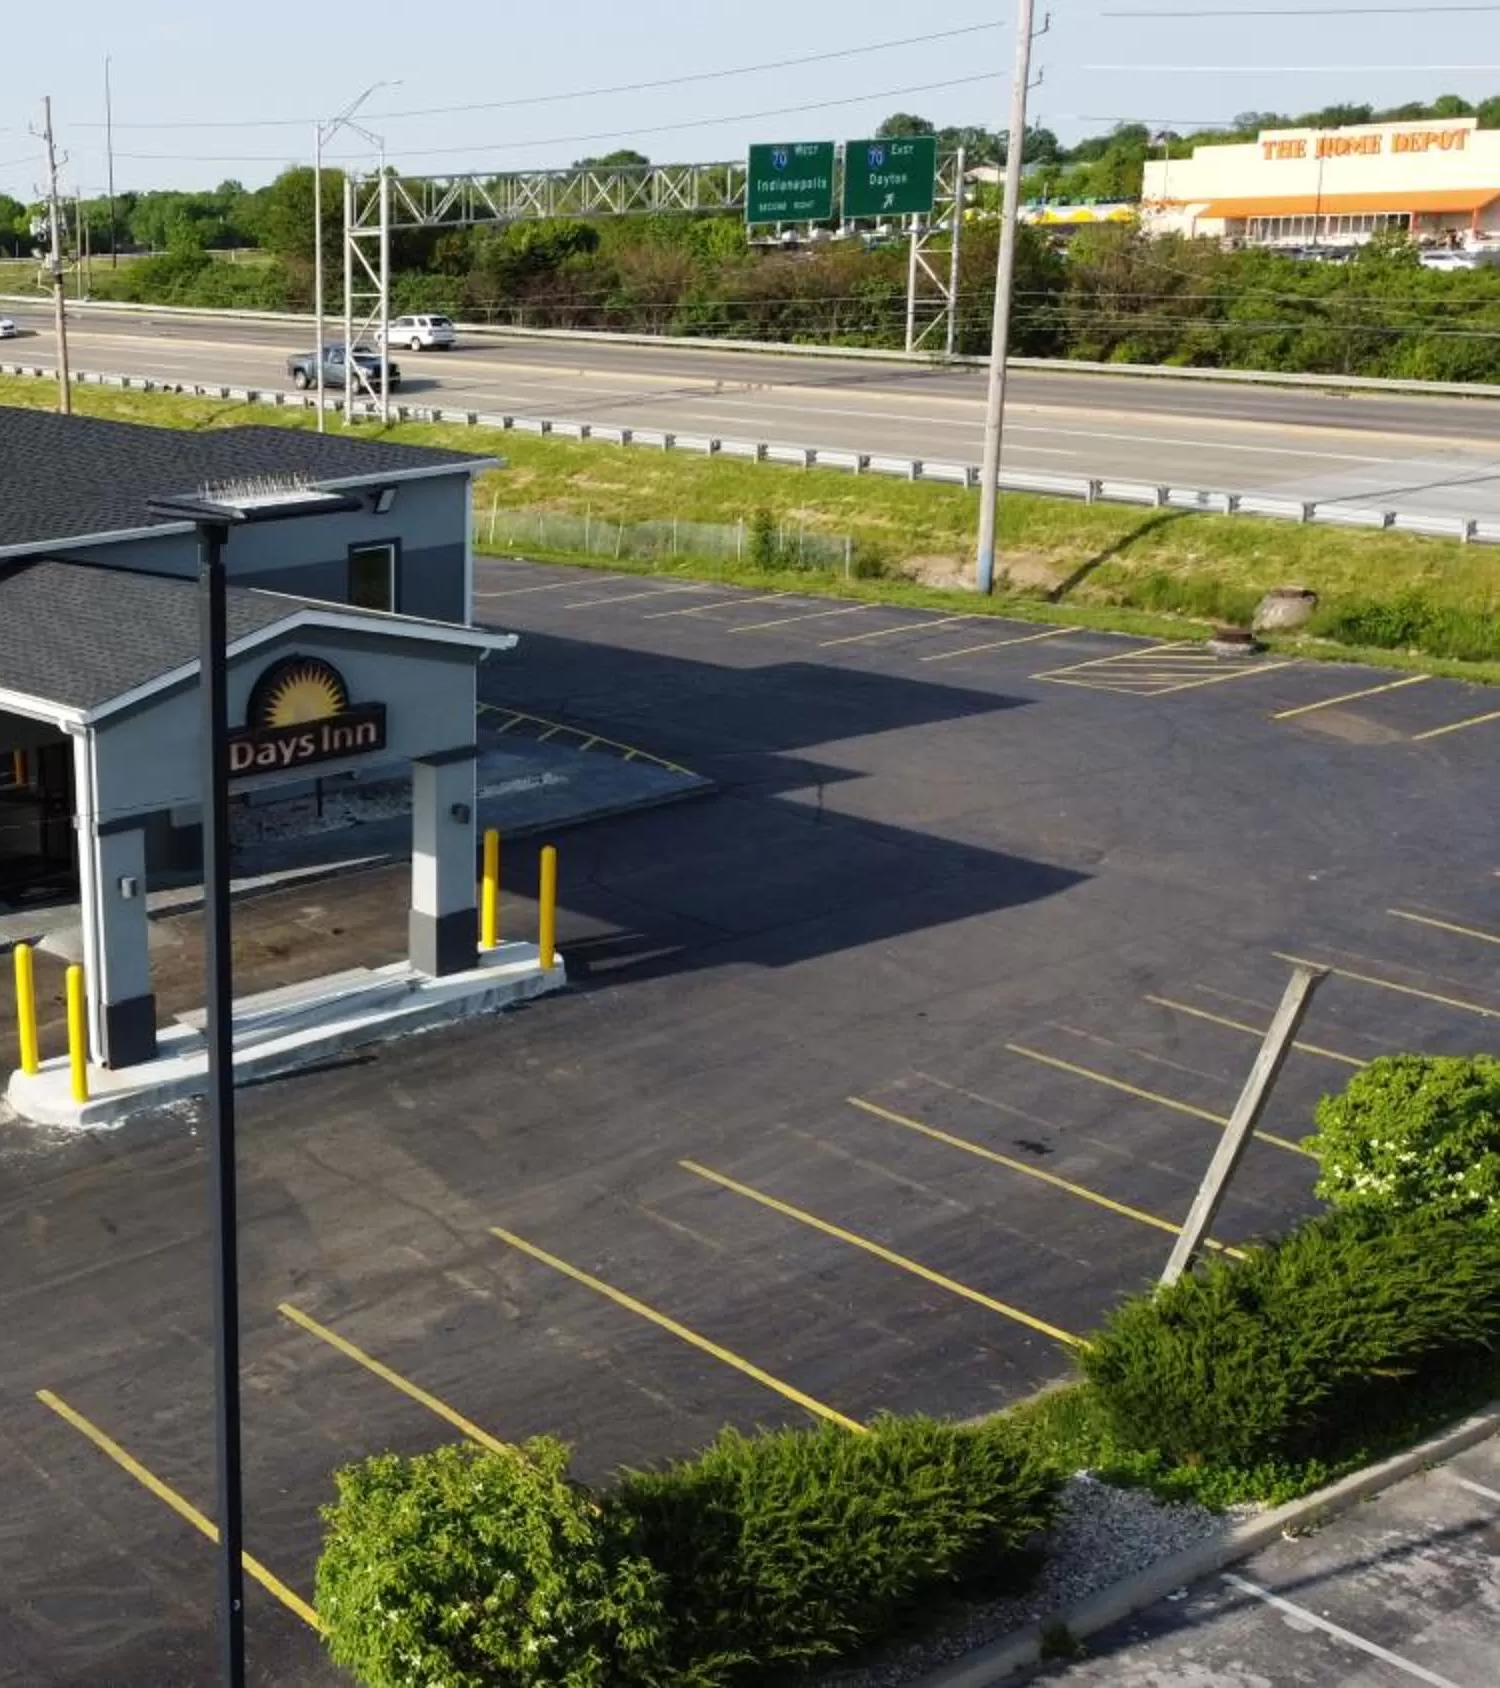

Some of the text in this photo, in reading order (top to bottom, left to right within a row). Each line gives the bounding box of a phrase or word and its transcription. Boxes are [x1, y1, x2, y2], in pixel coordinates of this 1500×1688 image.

[1263, 128, 1470, 160] THE HOME DEPOT
[772, 151, 787, 166] 70
[869, 151, 883, 166] 70
[757, 177, 827, 193] Indianapolis
[869, 173, 908, 188] Dayton
[230, 721, 377, 771] Days Inn
